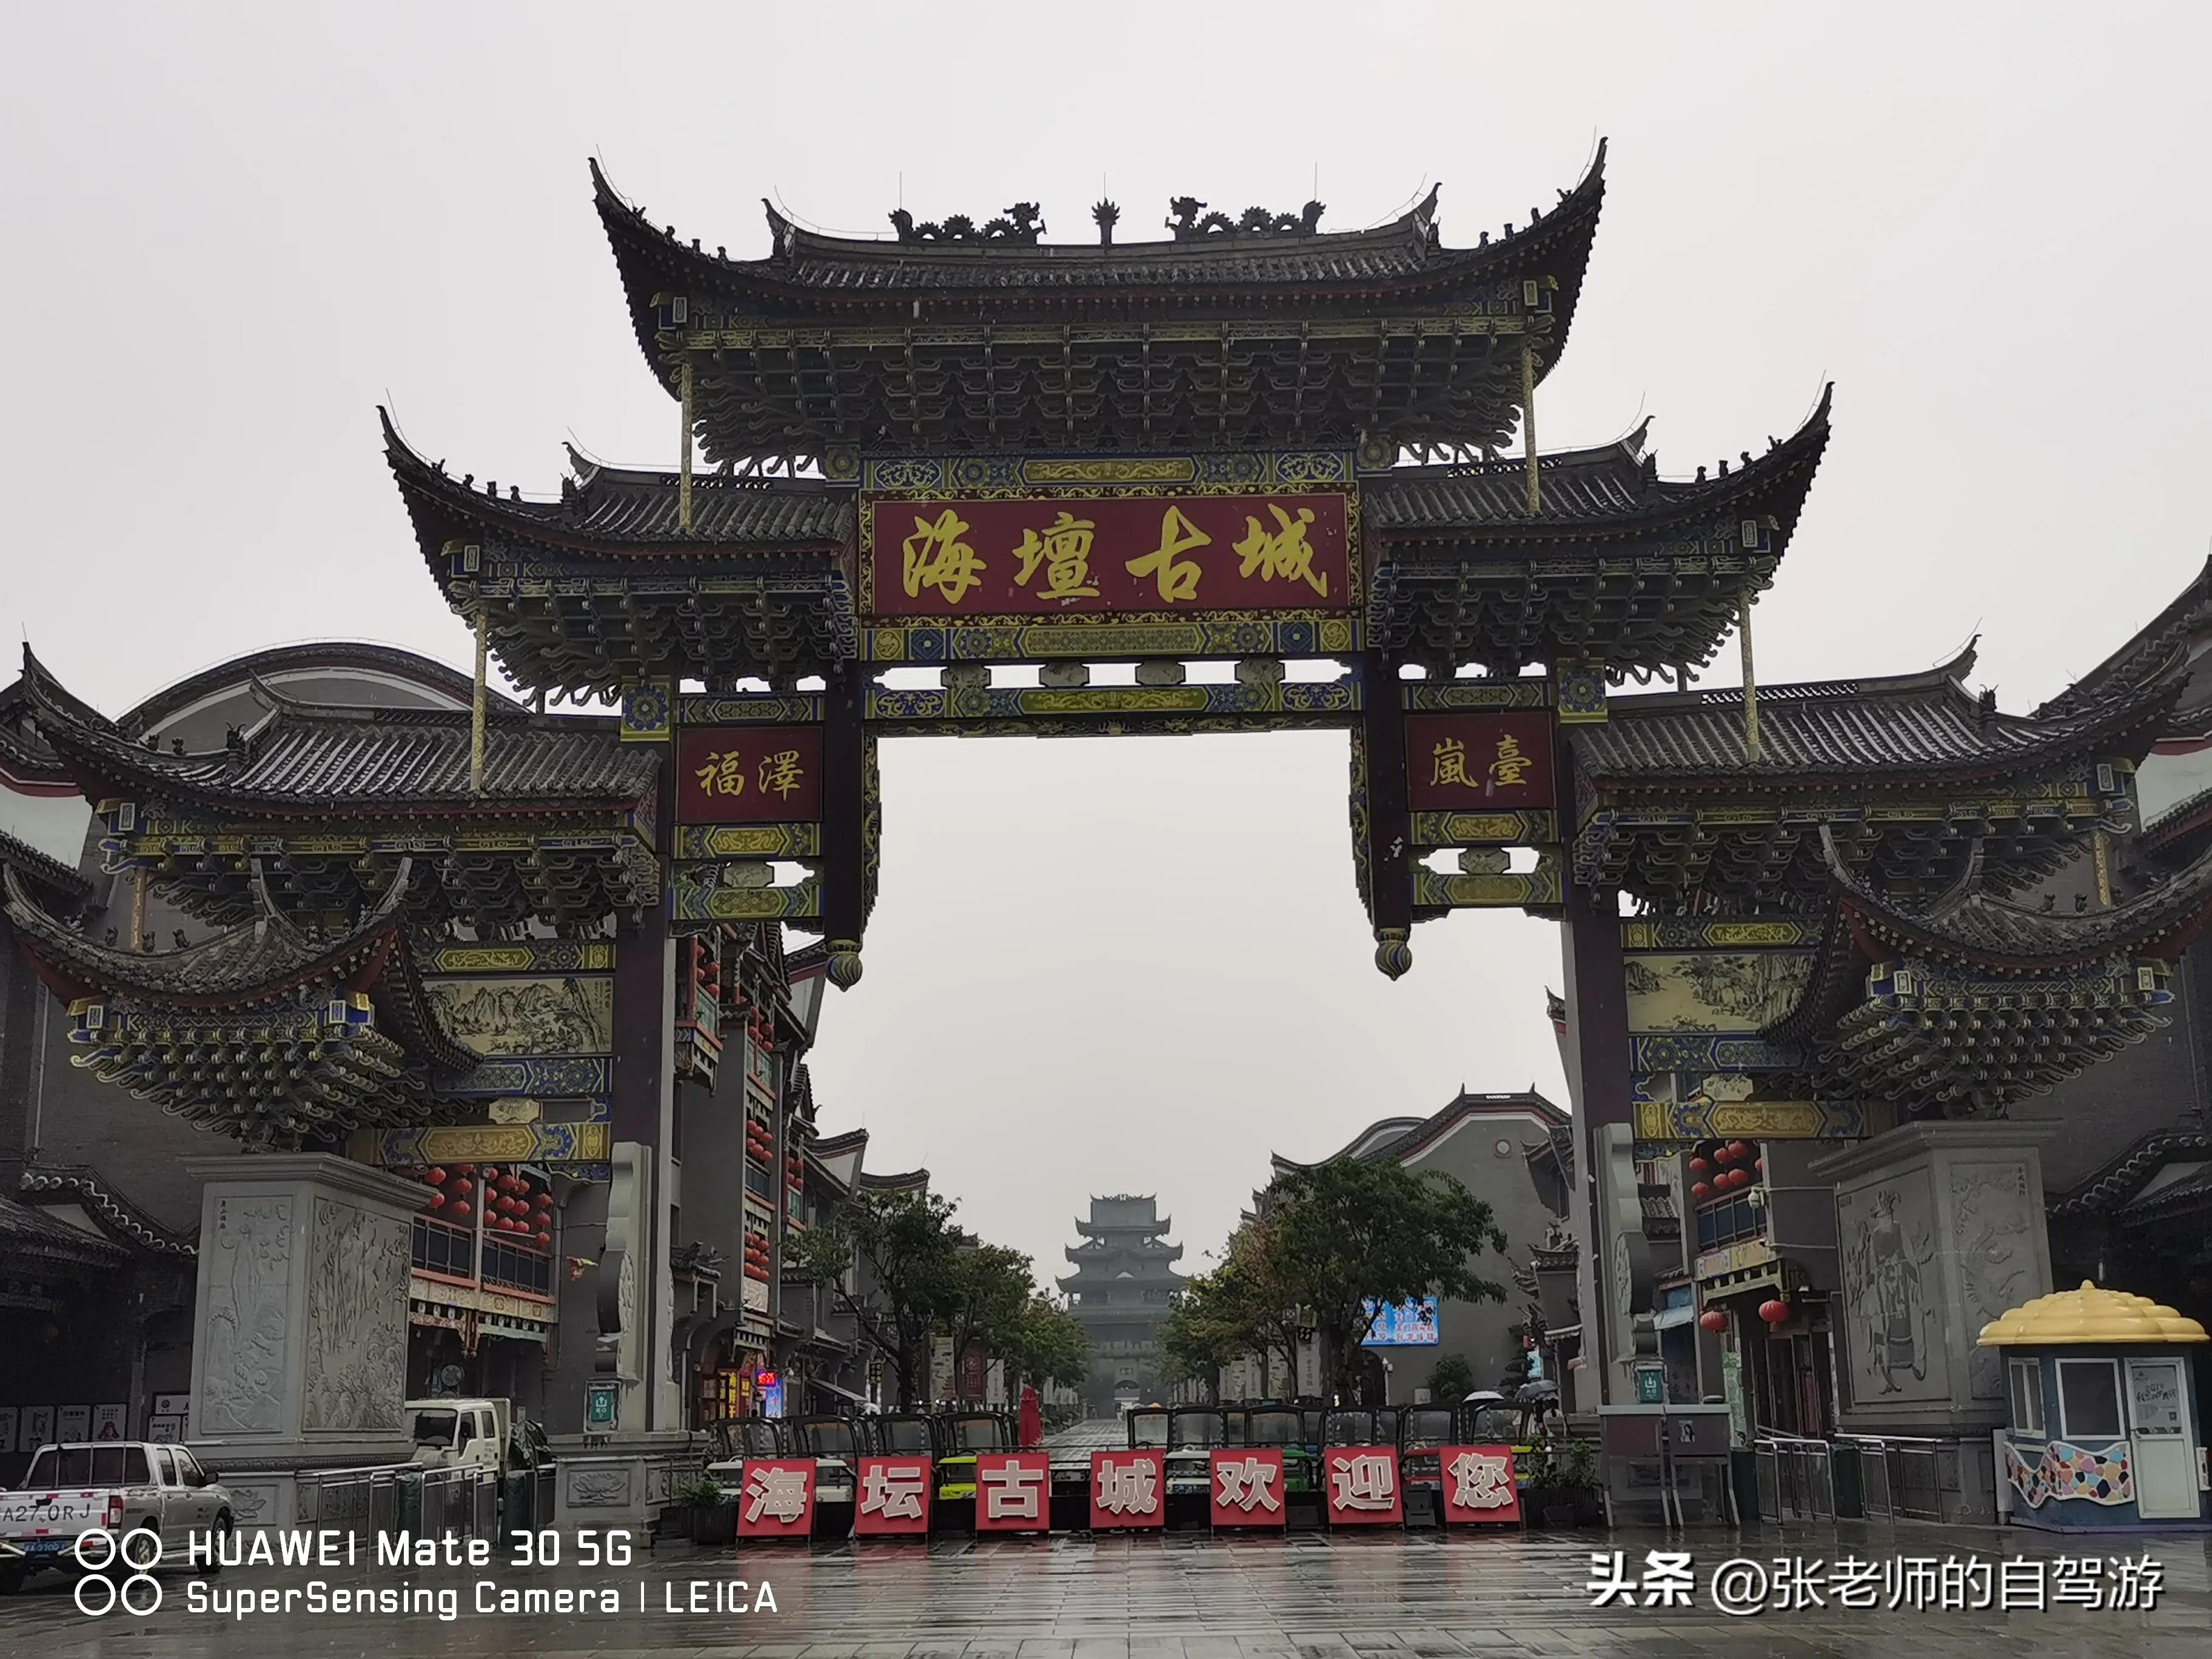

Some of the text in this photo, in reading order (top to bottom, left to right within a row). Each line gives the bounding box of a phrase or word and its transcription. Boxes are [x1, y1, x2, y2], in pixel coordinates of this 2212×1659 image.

[901, 503, 1328, 604] 海壇古城
[695, 750, 805, 802] 福澤
[1430, 734, 1533, 788] 嵐臺
[745, 1453, 1514, 1523] 海坛古城欢迎您
